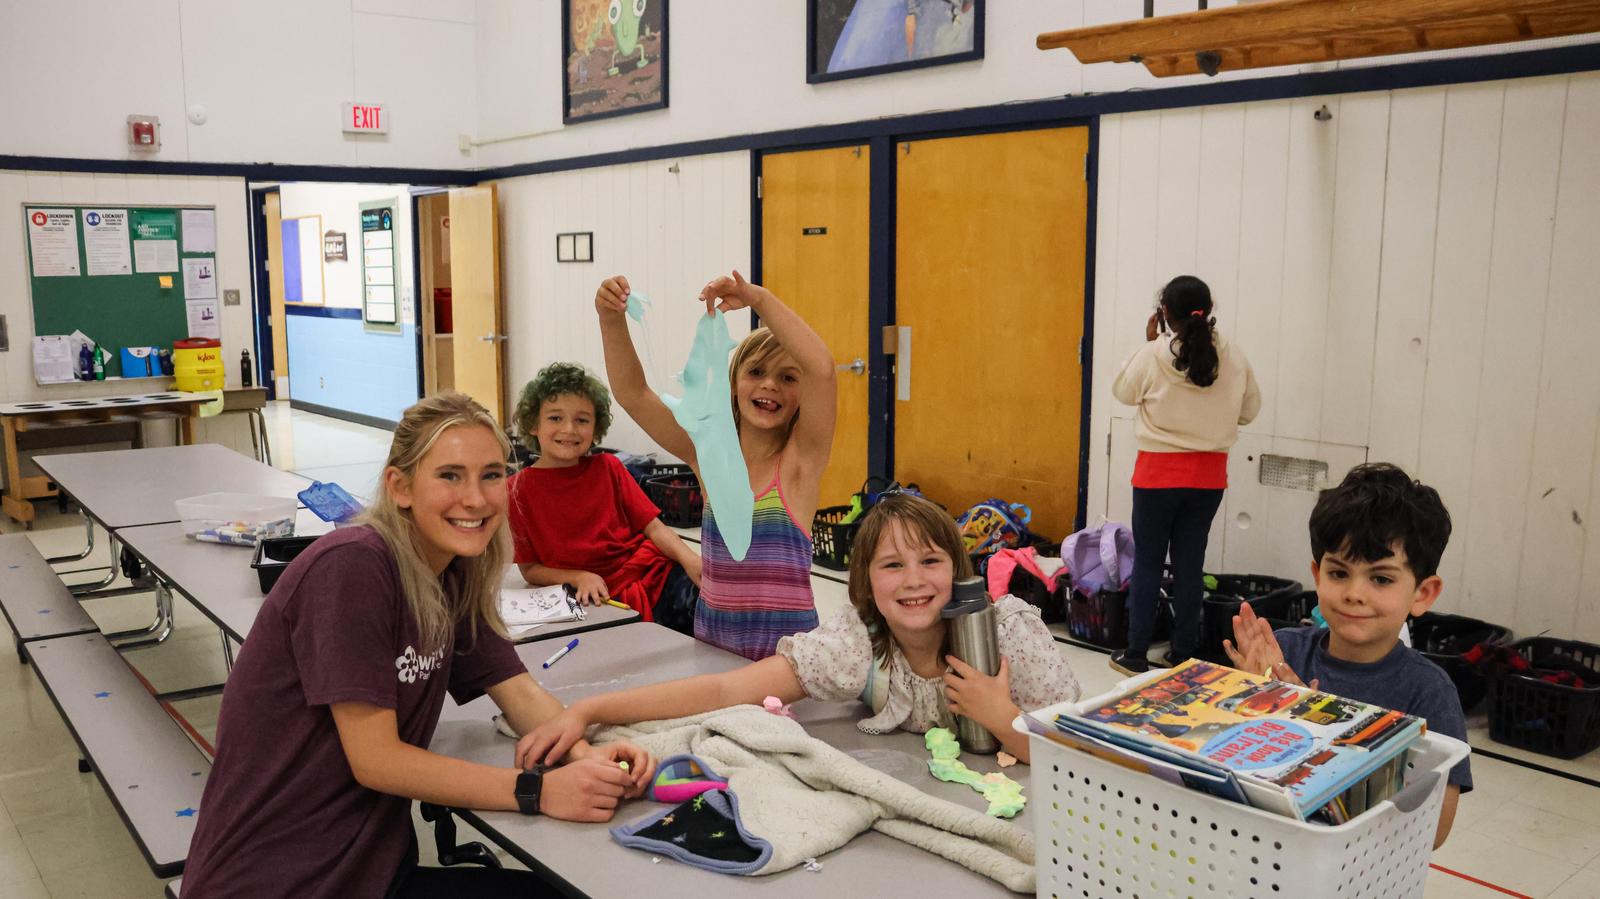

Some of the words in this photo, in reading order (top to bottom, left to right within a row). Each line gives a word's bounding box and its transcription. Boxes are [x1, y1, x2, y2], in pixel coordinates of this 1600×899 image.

[353, 106, 381, 128] EXIT
[1244, 722, 1286, 737] Big
[1270, 733, 1304, 746] Big
[1208, 736, 1264, 762] Trains
[1245, 744, 1284, 762] Book
